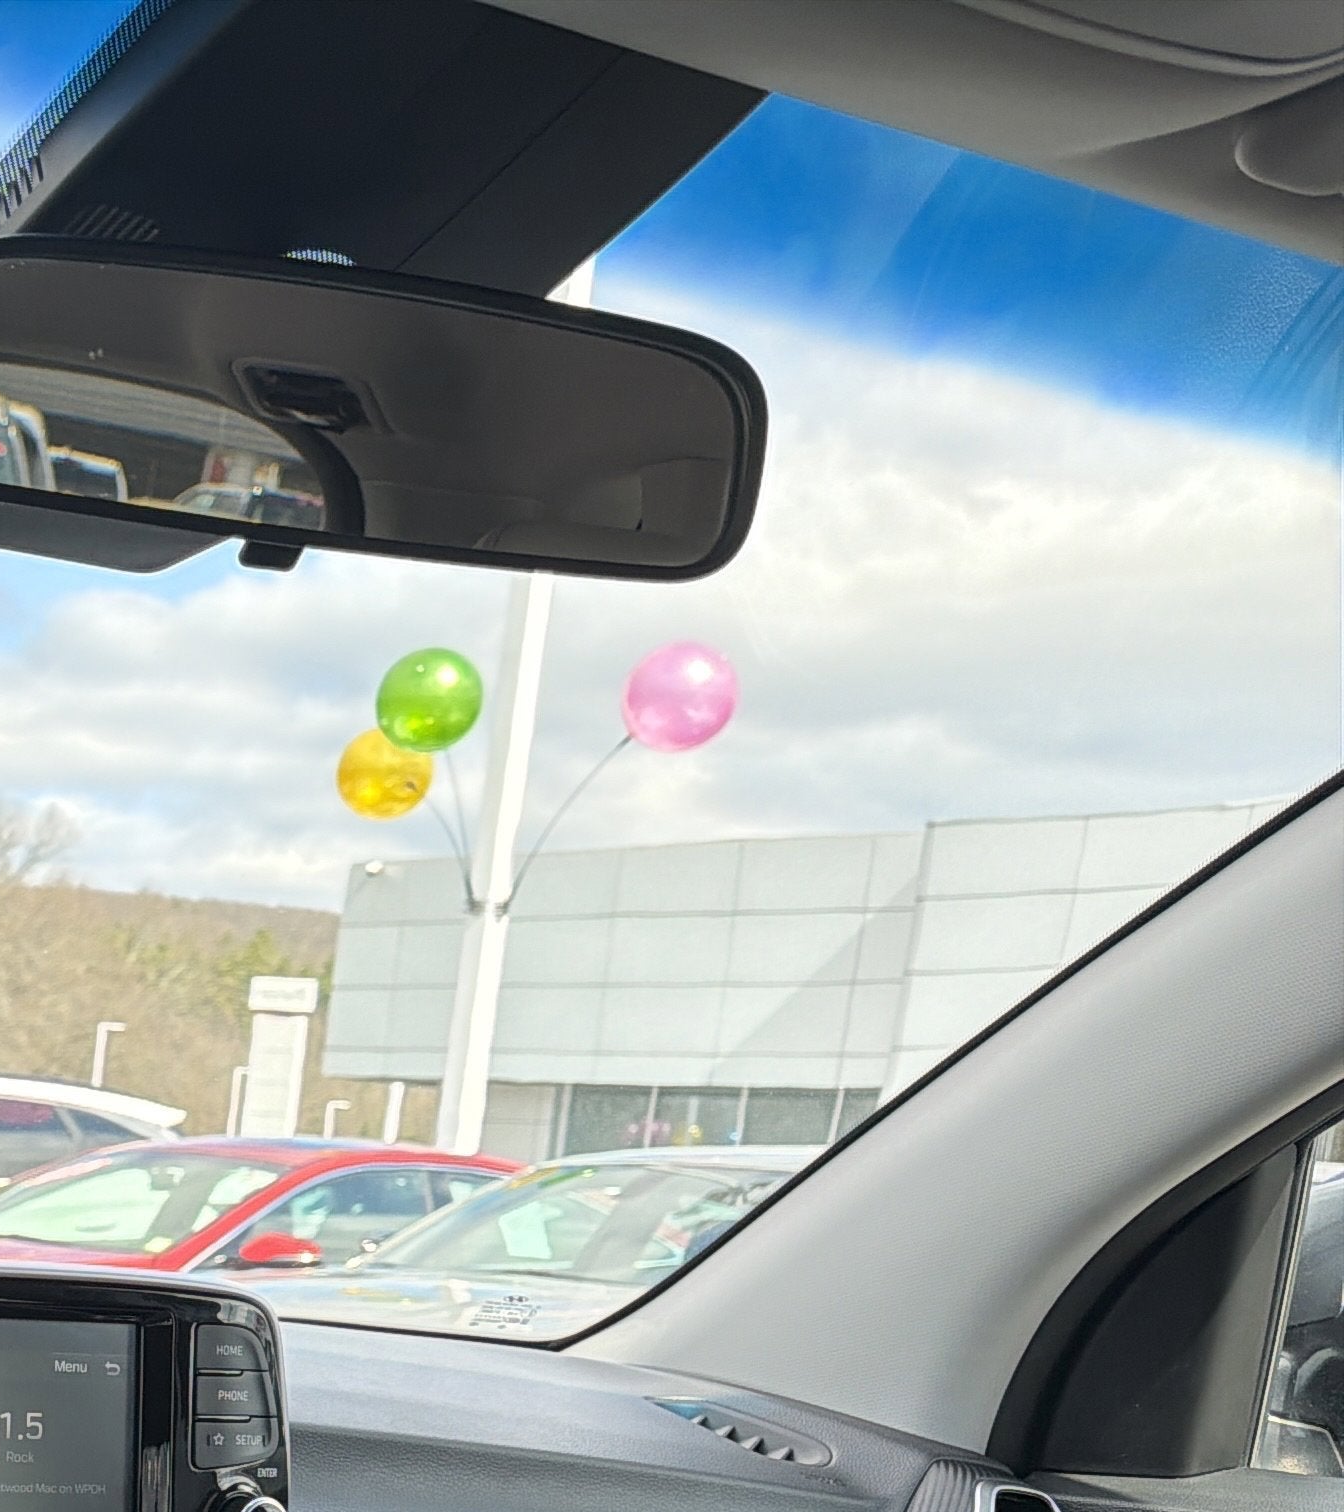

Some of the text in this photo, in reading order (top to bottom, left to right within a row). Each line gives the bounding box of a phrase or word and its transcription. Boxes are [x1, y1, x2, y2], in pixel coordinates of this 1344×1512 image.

[216, 1345, 243, 1357] HOME
[54, 1360, 88, 1374] Menu
[218, 1390, 249, 1401] PHONE
[235, 1434, 262, 1446] SETUP
[6, 1452, 34, 1463] Rock
[257, 1467, 277, 1477] ENTER
[35, 1483, 56, 1493] Mac
[59, 1486, 72, 1494] on
